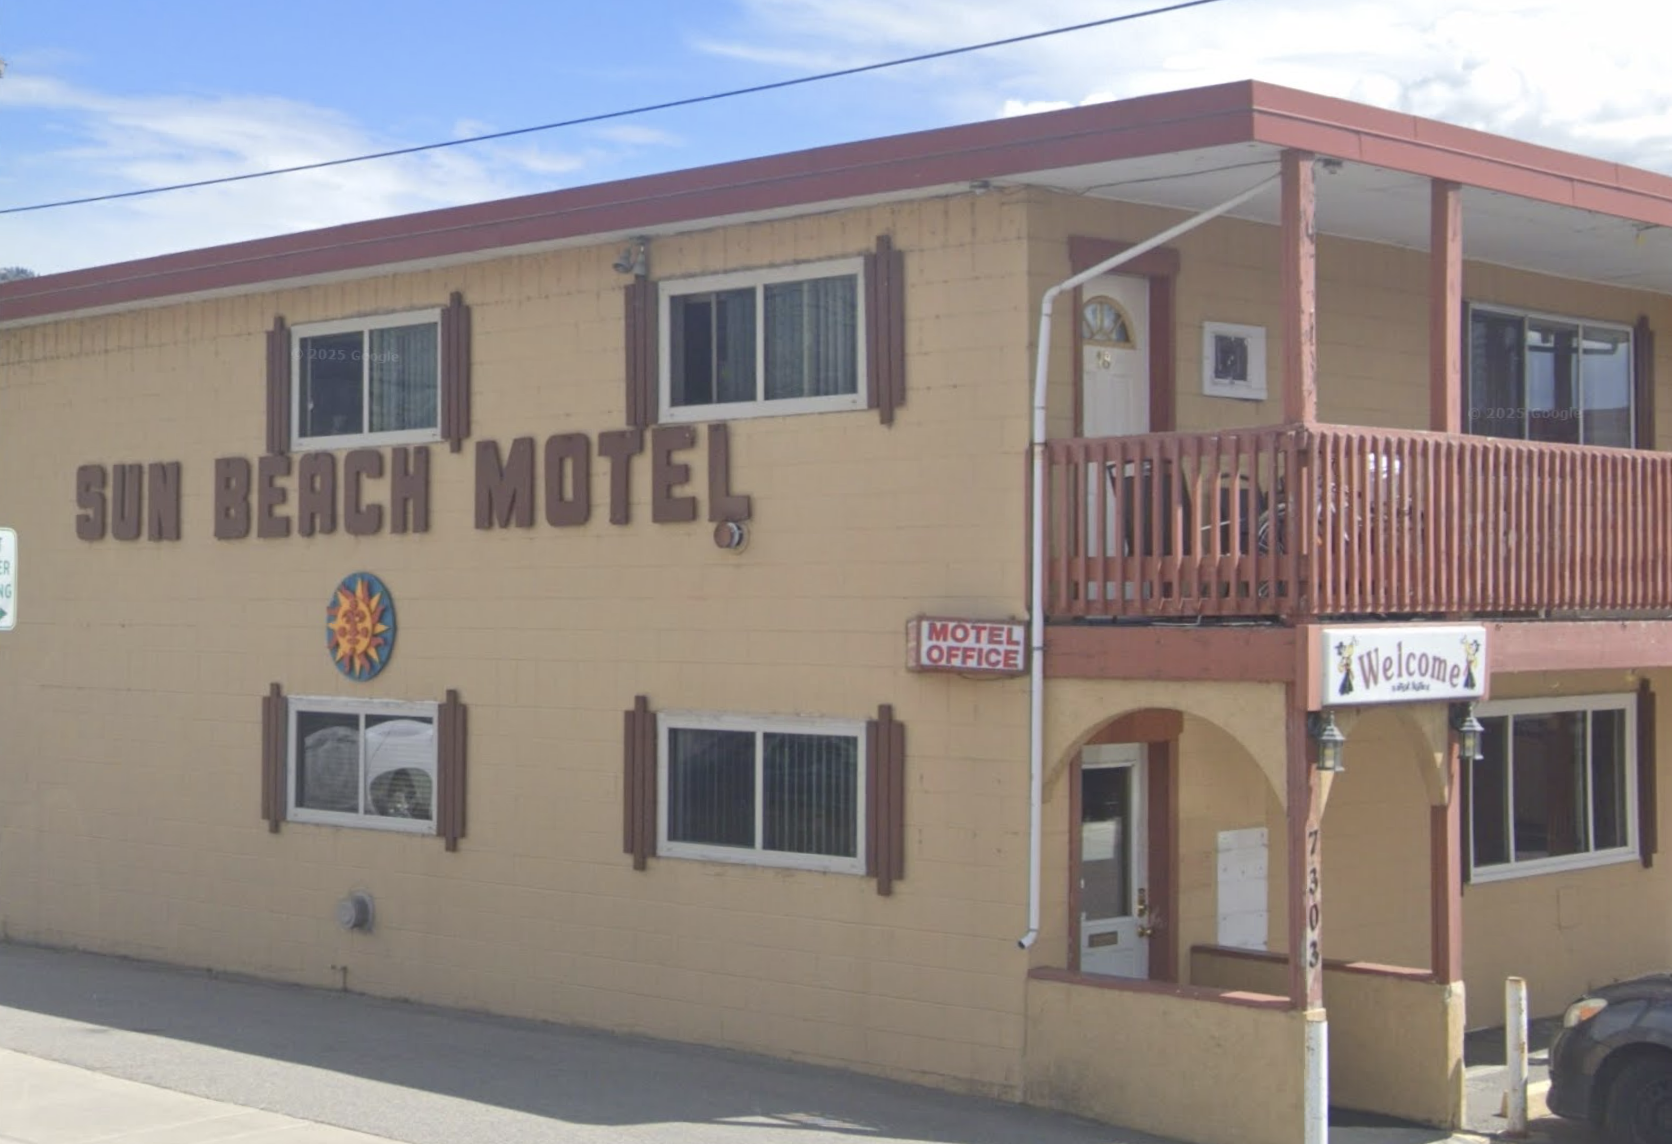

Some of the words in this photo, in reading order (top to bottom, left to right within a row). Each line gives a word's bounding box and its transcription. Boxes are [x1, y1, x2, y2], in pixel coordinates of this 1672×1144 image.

[75, 461, 182, 541] SUN
[213, 446, 430, 540] BEACH
[475, 423, 752, 529] MOTEL
[926, 645, 1020, 668] OFFICE
[928, 622, 1021, 646] MOTEL
[1358, 641, 1461, 688] Welcome
[1308, 829, 1319, 969] 7303
